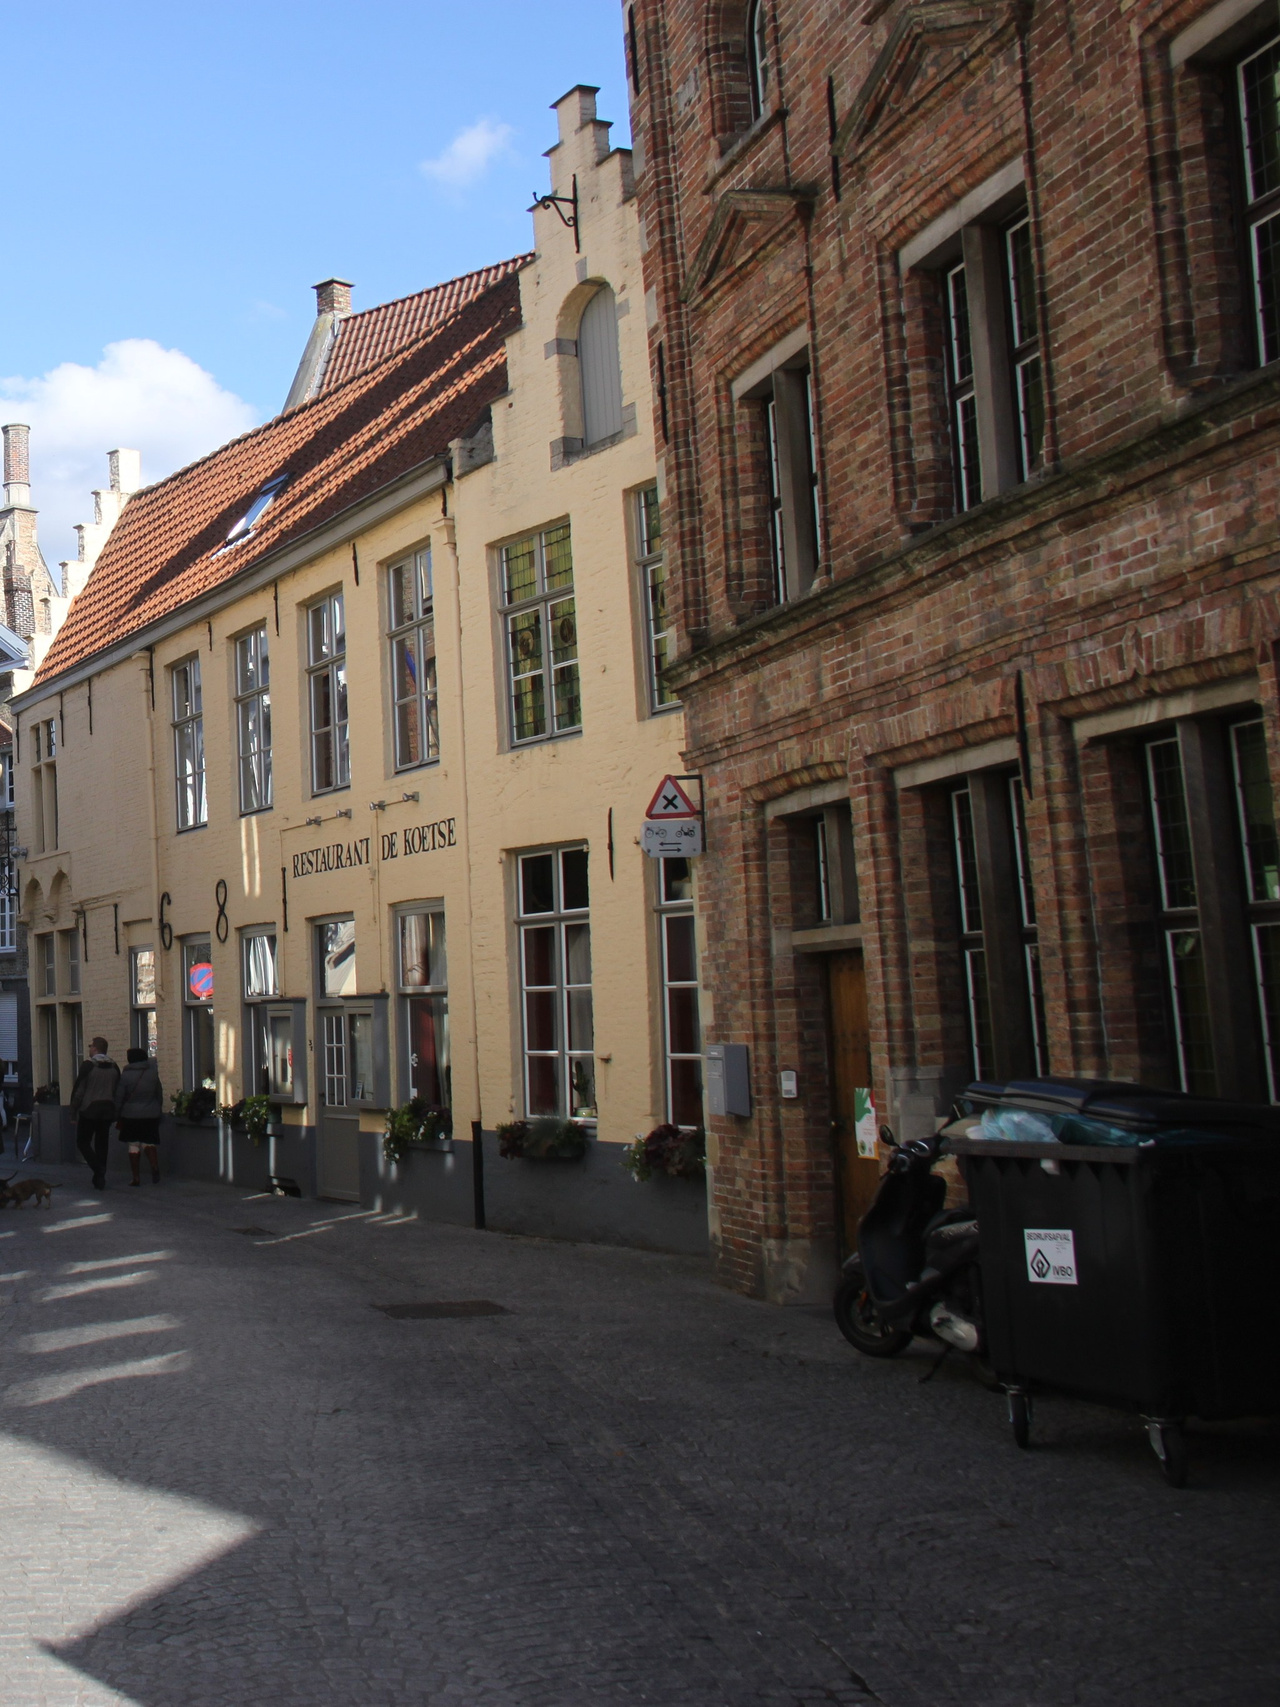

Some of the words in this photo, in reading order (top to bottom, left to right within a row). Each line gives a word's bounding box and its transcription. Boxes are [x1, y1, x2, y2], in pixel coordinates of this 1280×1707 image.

[293, 837, 370, 878] RESTAURANT
[381, 832, 398, 860] DE
[403, 818, 457, 856] KOETSE
[1052, 1266, 1073, 1276] IVBO
